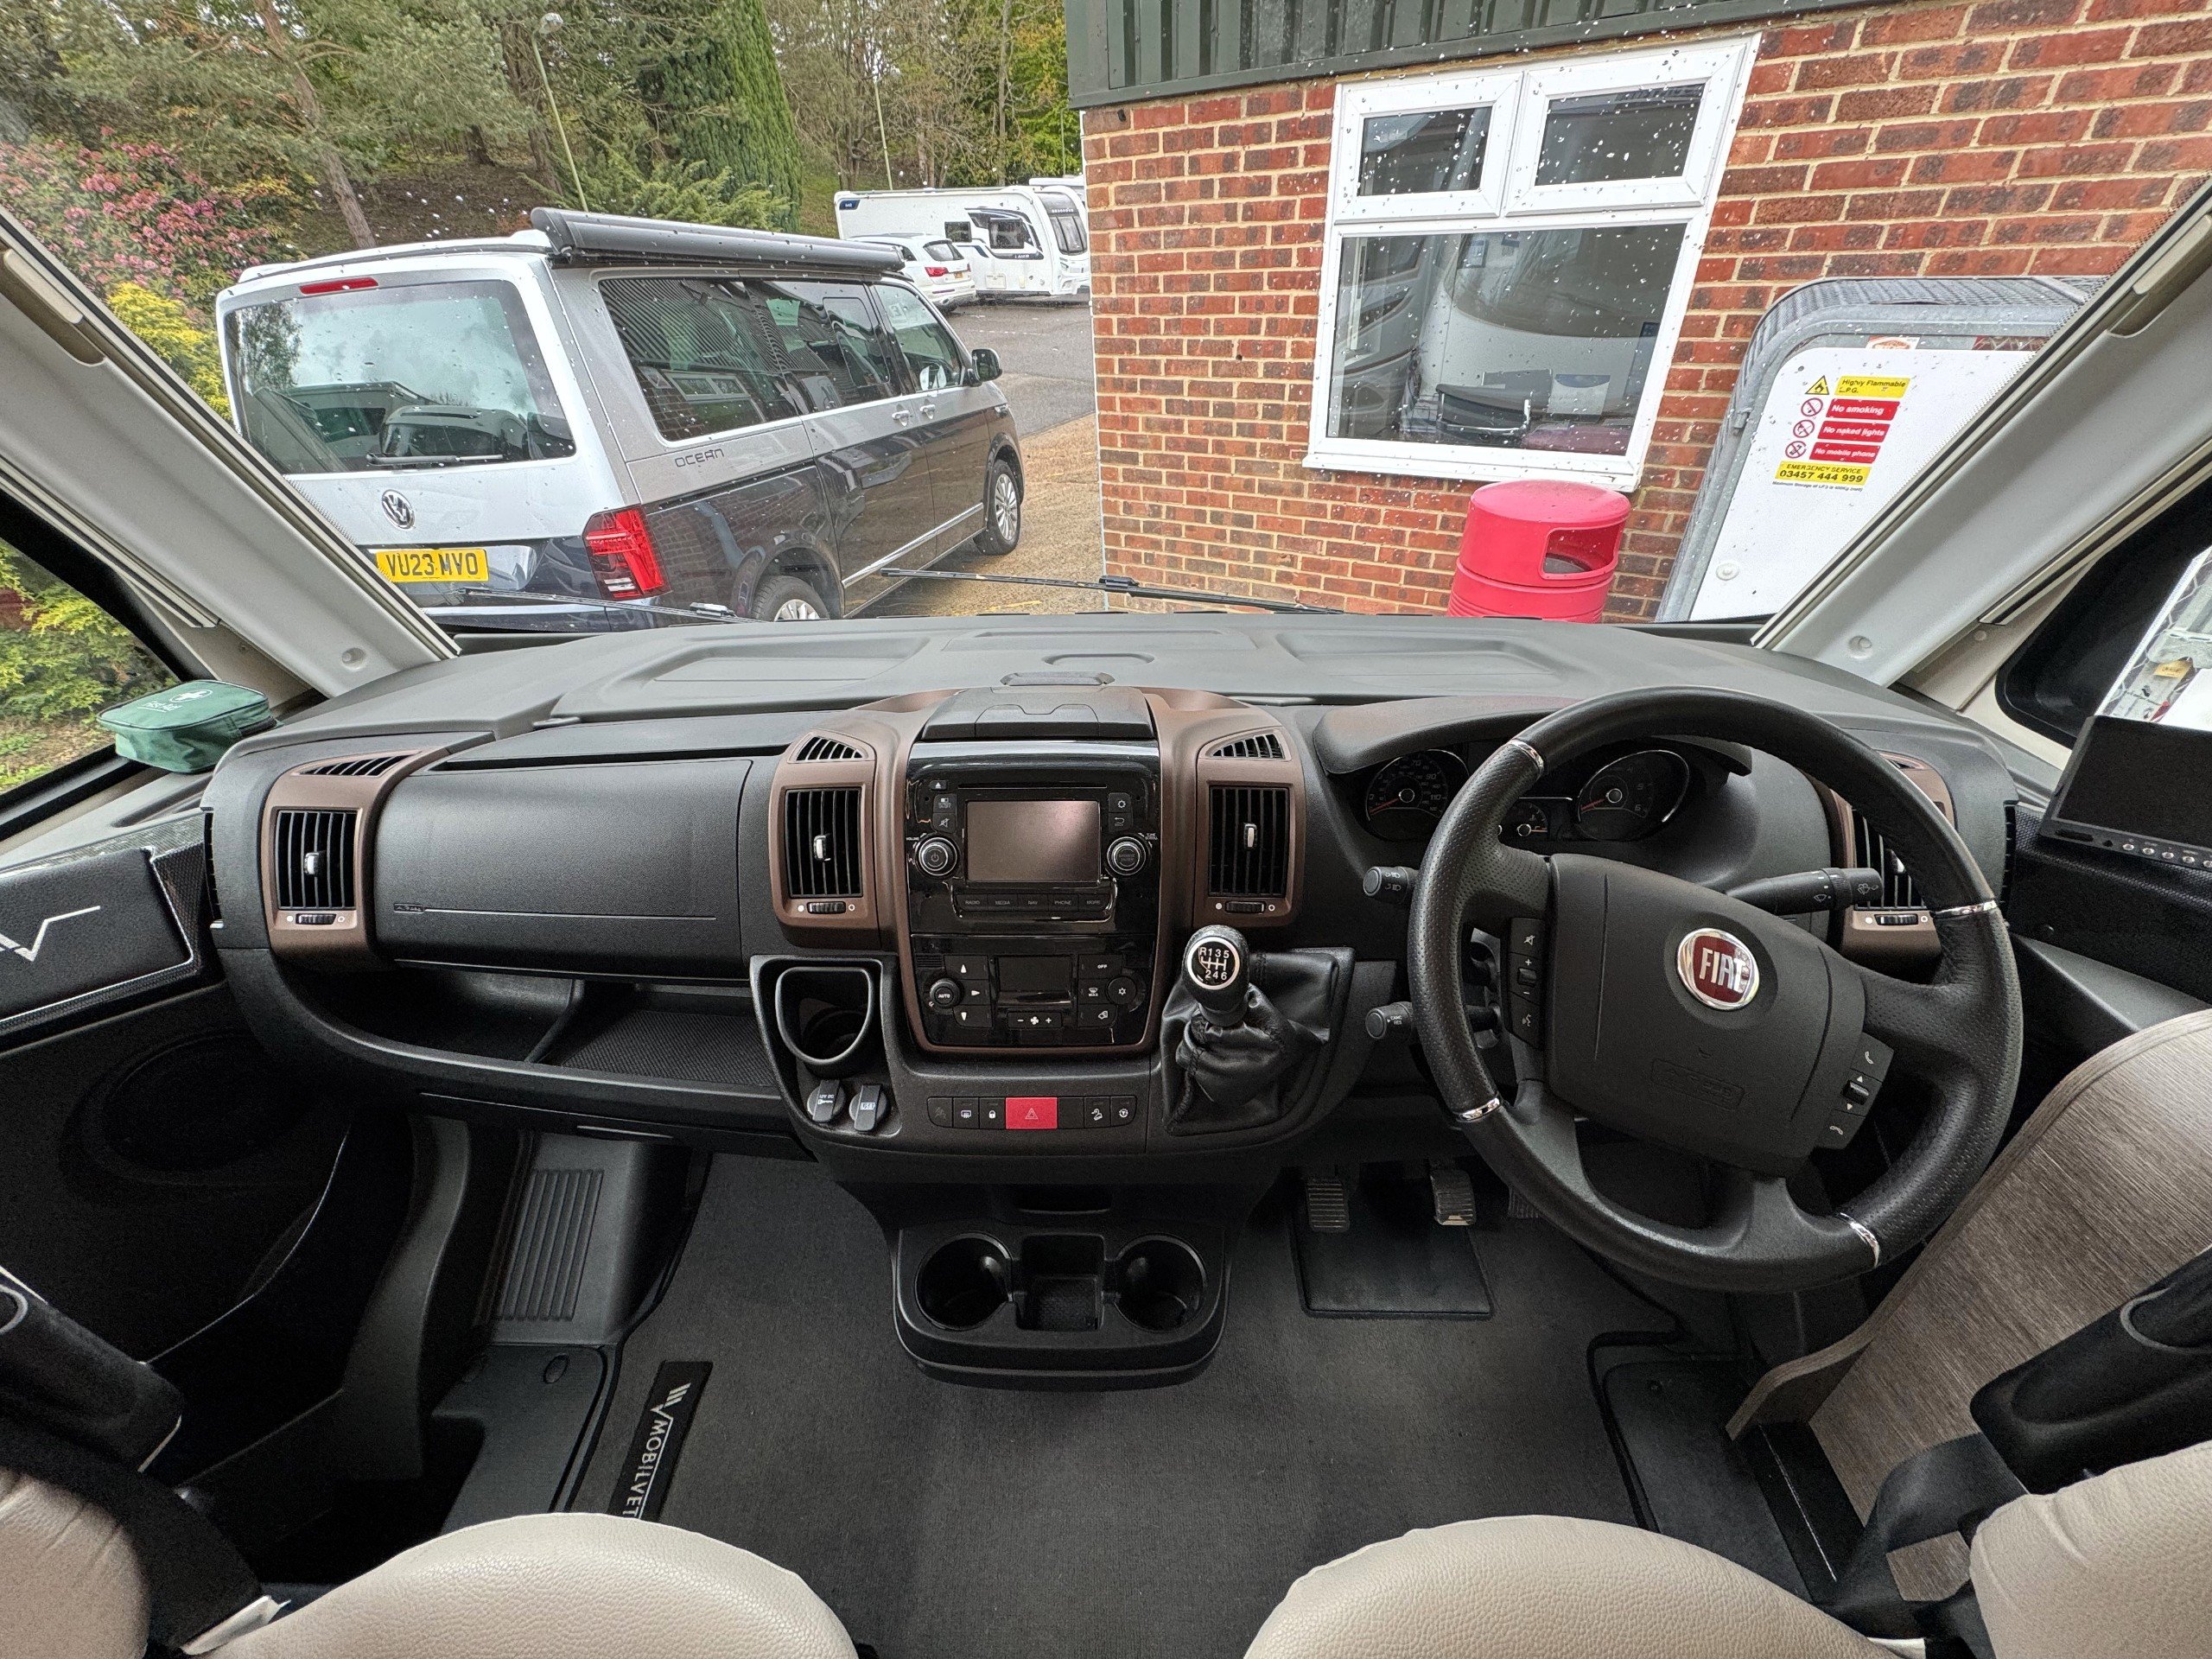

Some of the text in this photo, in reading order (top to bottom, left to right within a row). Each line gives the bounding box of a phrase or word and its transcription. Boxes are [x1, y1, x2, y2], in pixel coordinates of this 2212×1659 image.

[1846, 406, 1885, 415] smoking
[675, 448, 725, 467] OCEAN
[1780, 470, 1815, 479] 03457
[1787, 463, 1830, 472] EMERGENCY
[386, 550, 479, 575] VU23 MVO
[1699, 947, 1745, 994] FIAT
